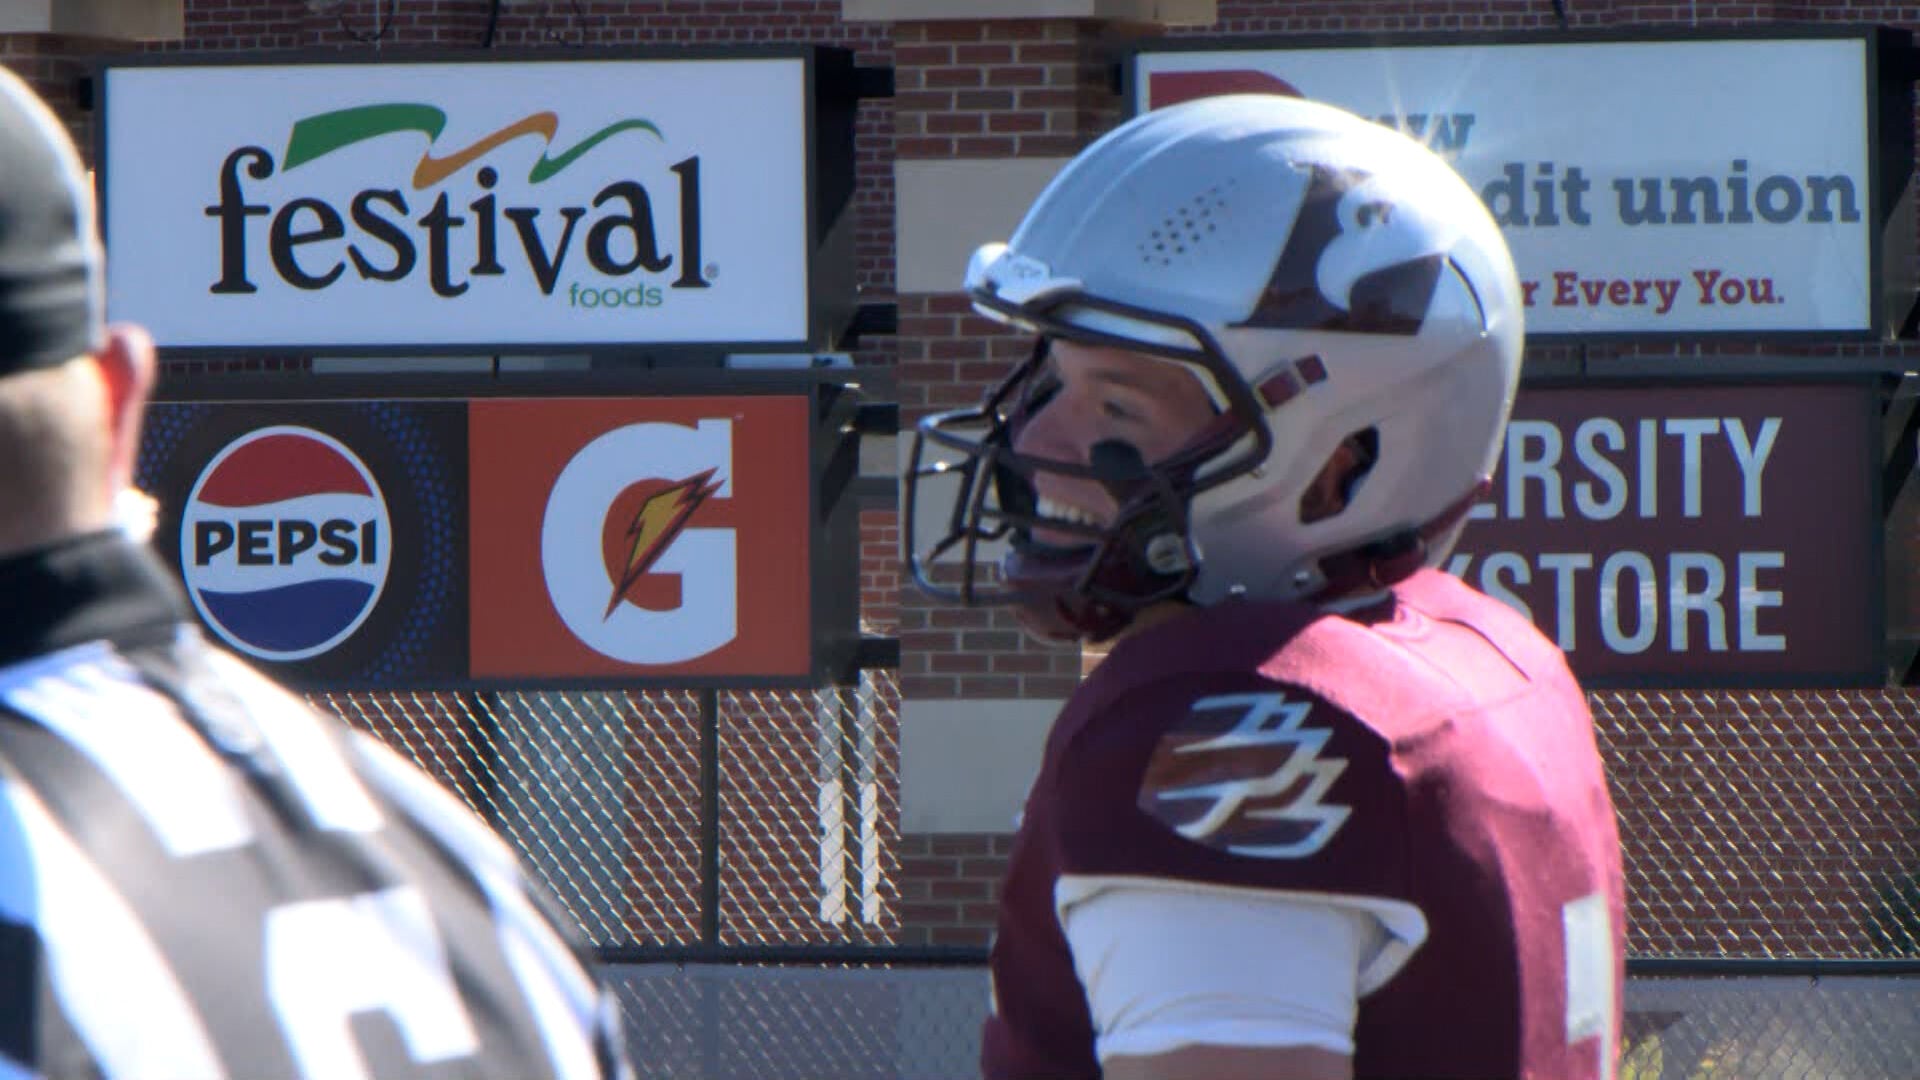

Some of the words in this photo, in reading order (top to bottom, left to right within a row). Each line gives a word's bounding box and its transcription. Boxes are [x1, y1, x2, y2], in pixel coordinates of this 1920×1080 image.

[205, 145, 712, 298] festival
[1612, 159, 1860, 224] union
[569, 282, 663, 309] foods
[1553, 271, 1681, 314] Every
[1692, 269, 1785, 306] You.
[1469, 417, 1783, 521] RSITY
[194, 519, 377, 567] PEPSI
[1449, 551, 1786, 655] STORE
